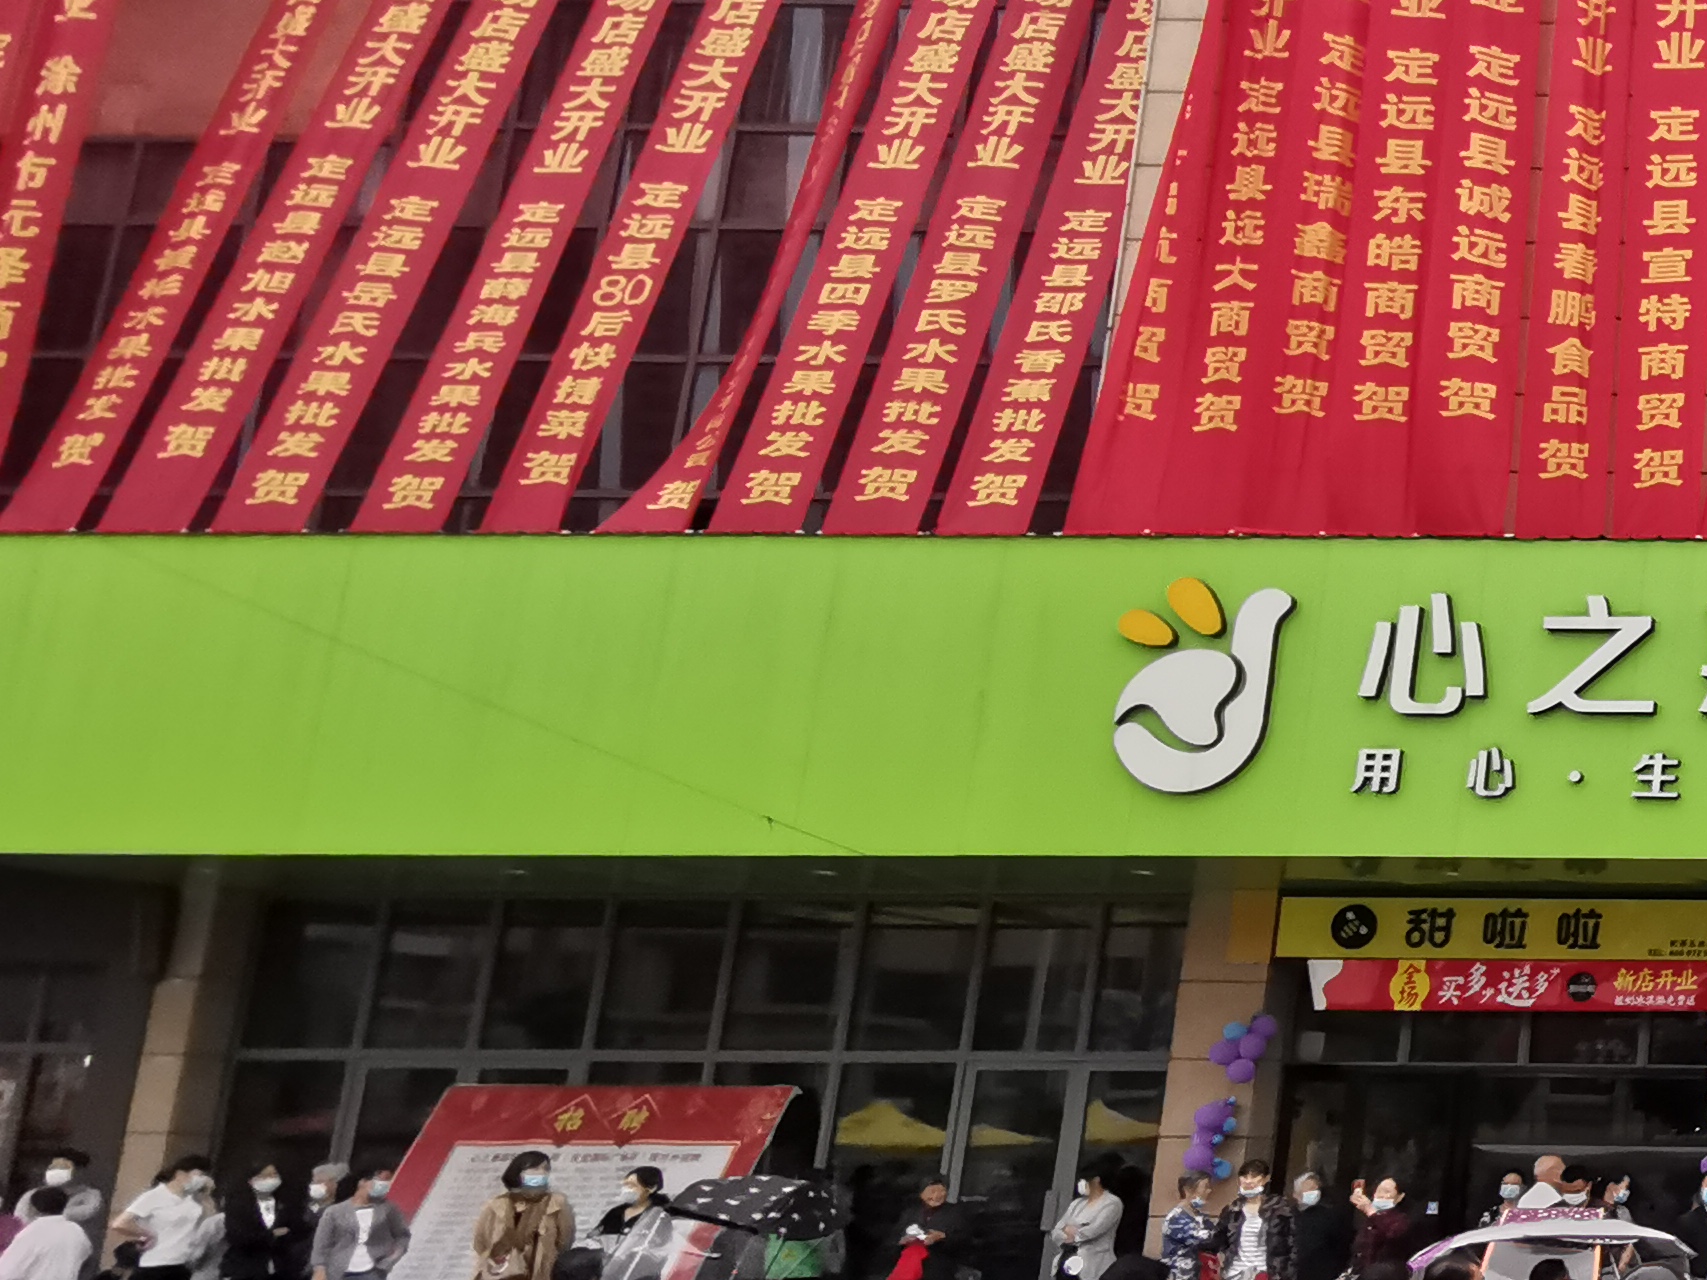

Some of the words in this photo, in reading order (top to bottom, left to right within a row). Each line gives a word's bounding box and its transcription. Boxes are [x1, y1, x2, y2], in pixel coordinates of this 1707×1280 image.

[744, 198, 902, 505] 定远县四季水果批发贺
[857, 196, 1006, 501] 定远县罗氏水果批发贺
[1194, 81, 1283, 432] 定远县远大商贸贺
[1441, 47, 1520, 420] 定远县诚远商贸贺
[1399, 964, 1419, 1008] 全场
[1404, 907, 1603, 950] 甜啦啦
[1613, 968, 1698, 992] 新店开业
